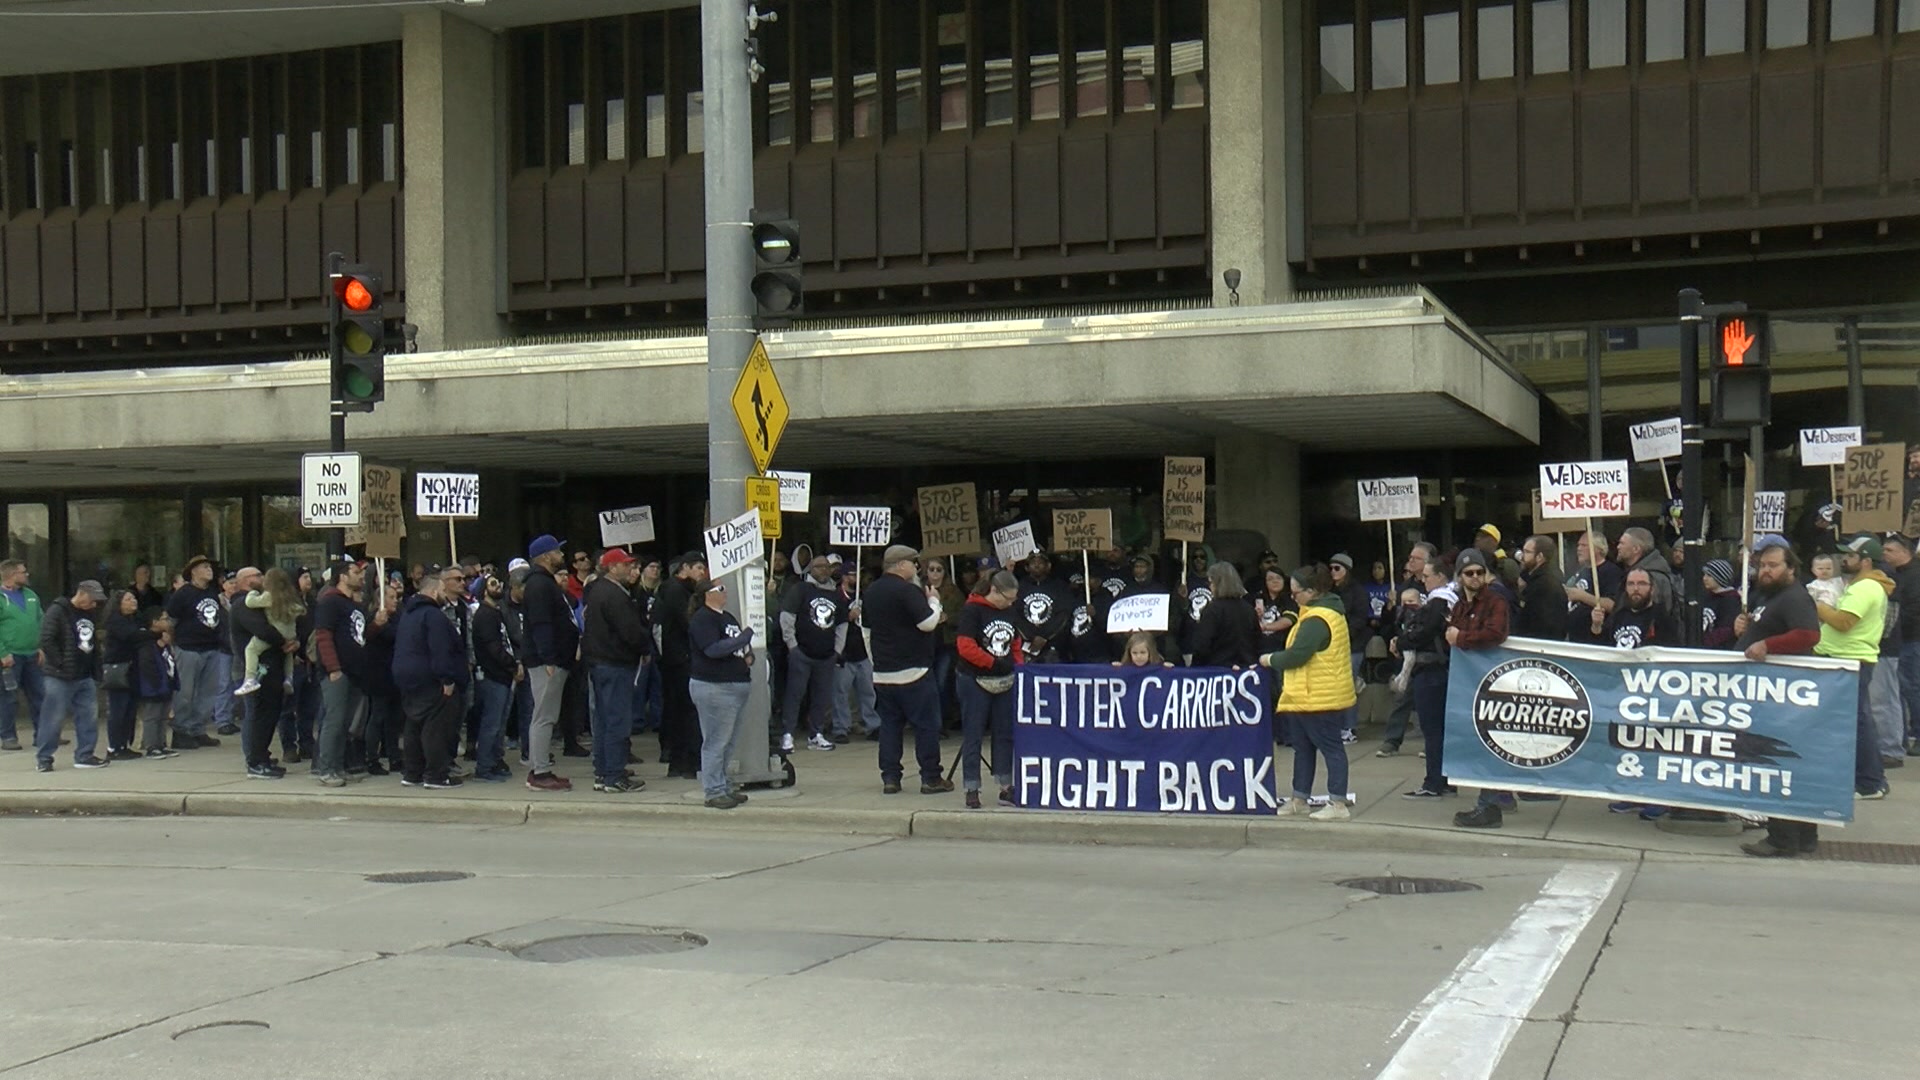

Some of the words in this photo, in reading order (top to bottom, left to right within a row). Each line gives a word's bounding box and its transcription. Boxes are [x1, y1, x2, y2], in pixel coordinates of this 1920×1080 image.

[322, 463, 341, 477] NO
[1849, 450, 1884, 471] STOP
[367, 469, 391, 489] STOP
[421, 478, 446, 494] NO
[446, 478, 479, 495] WAGE
[1177, 477, 1188, 490] IS
[1847, 470, 1889, 490] WAGE
[317, 483, 347, 497] TURN
[756, 485, 770, 496] CROSS
[920, 486, 964, 506] STOP
[1167, 489, 1203, 504] ENOUGH
[311, 503, 329, 517] ON
[330, 503, 352, 516] RED
[369, 493, 396, 512] WAGE
[425, 496, 478, 514] THEFT!
[1560, 492, 1628, 511] RESPECT
[1845, 490, 1898, 512] THEFT
[367, 514, 399, 534] THEFT
[833, 510, 856, 525] NO
[856, 510, 889, 526] WAGE
[924, 503, 970, 526] WAGE
[1057, 511, 1087, 525] STOP
[1753, 512, 1783, 529] HEFT!
[837, 526, 888, 544] THEFT!
[924, 526, 976, 547] THEFT
[1064, 524, 1097, 537] WAGE
[1064, 536, 1105, 550] THEFT
[1487, 660, 1542, 683] WORKING
[1548, 665, 1581, 692] CLASS
[1621, 668, 1820, 707] WORKING
[1017, 672, 1126, 729] LETTER
[1138, 670, 1263, 730] CARRIERS
[1512, 695, 1553, 705] YOUNG
[1479, 699, 1589, 730] WORKERS
[1618, 696, 1752, 729] CLASS
[1495, 722, 1567, 735] COMMITTEE
[1616, 724, 1736, 759] UNITE
[1487, 741, 1518, 764] UNITE
[1526, 759, 1533, 767] &
[1540, 746, 1574, 765] FIGHT
[1020, 756, 1145, 808] FIGHT
[1159, 756, 1277, 812] BACK
[1616, 753, 1645, 778] &
[1657, 755, 1792, 797] FIGHT!
